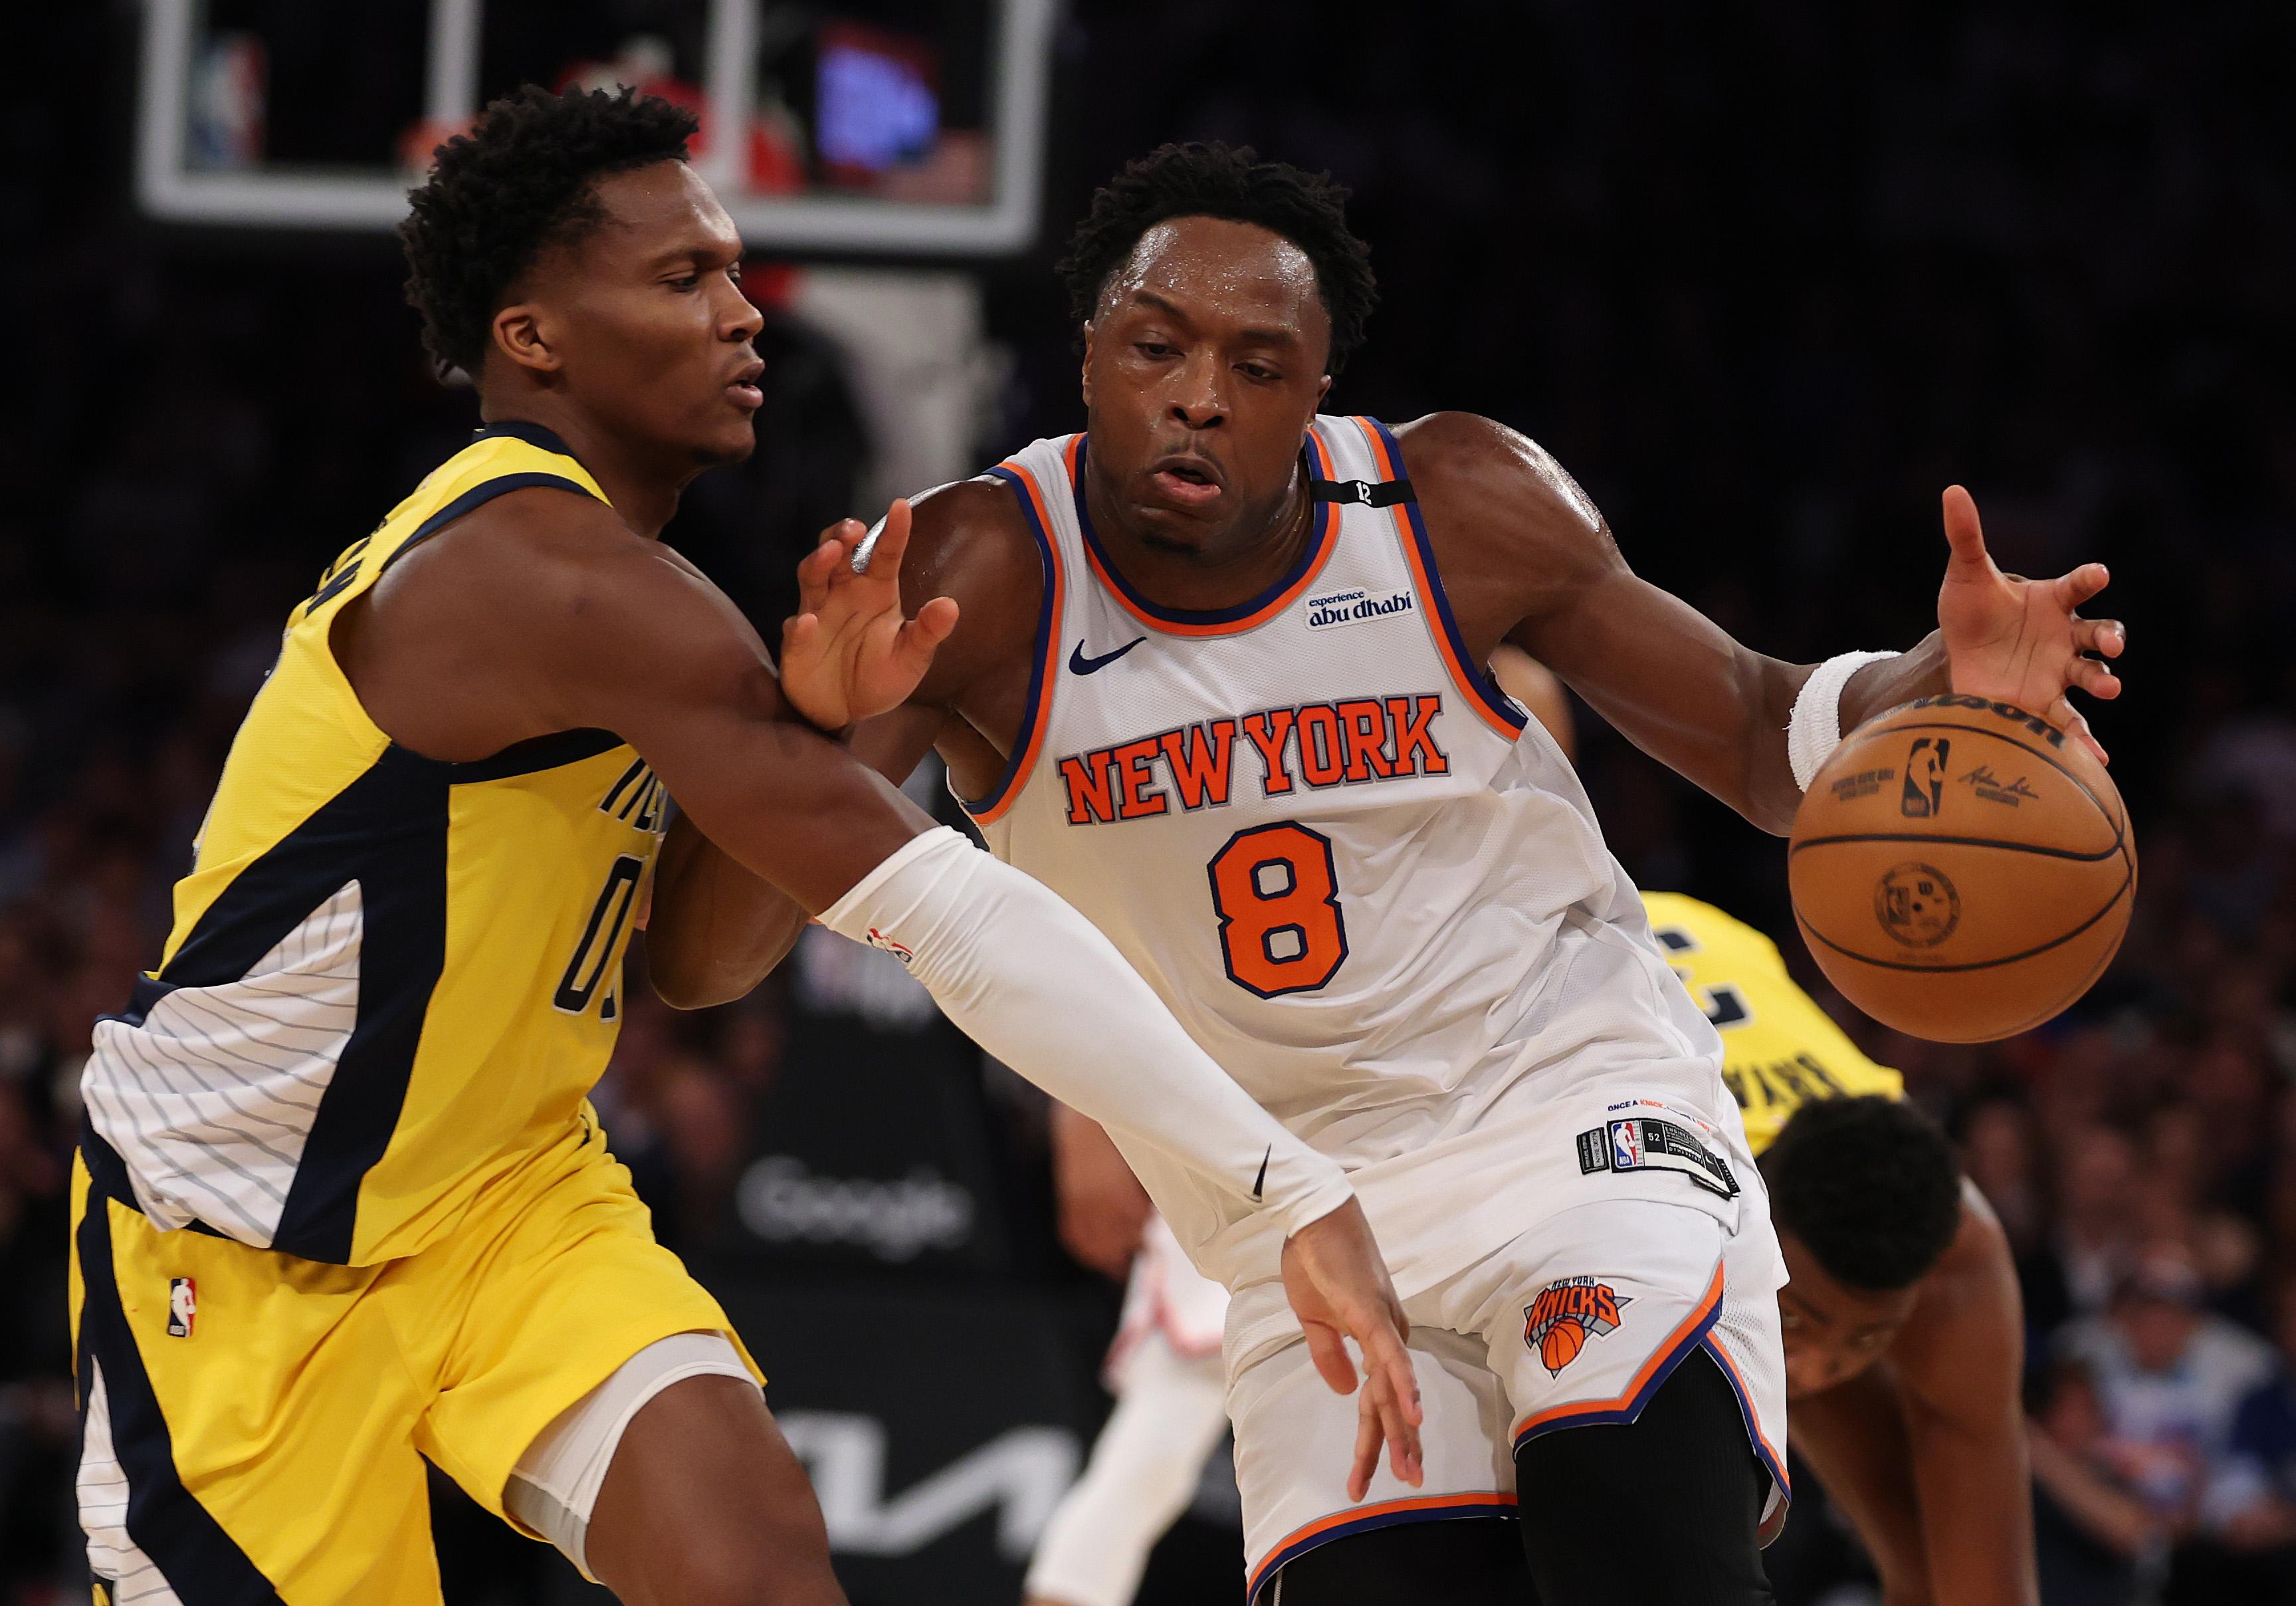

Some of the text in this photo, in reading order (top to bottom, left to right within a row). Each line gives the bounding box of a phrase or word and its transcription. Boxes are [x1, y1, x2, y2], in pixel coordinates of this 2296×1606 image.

[1356, 481, 1372, 505] 12
[1308, 590, 1364, 607] experience
[1309, 607, 1350, 627] abu
[1059, 693, 1451, 826] NEW YORK
[1207, 820, 1349, 1000] 8
[1608, 1101, 1631, 1111] ONCE
[1648, 1132, 1660, 1142] 52
[1619, 1156, 1630, 1165] NBA
[1552, 1276, 1595, 1290] NEW YORK
[1524, 1284, 1621, 1340] KNICKS
